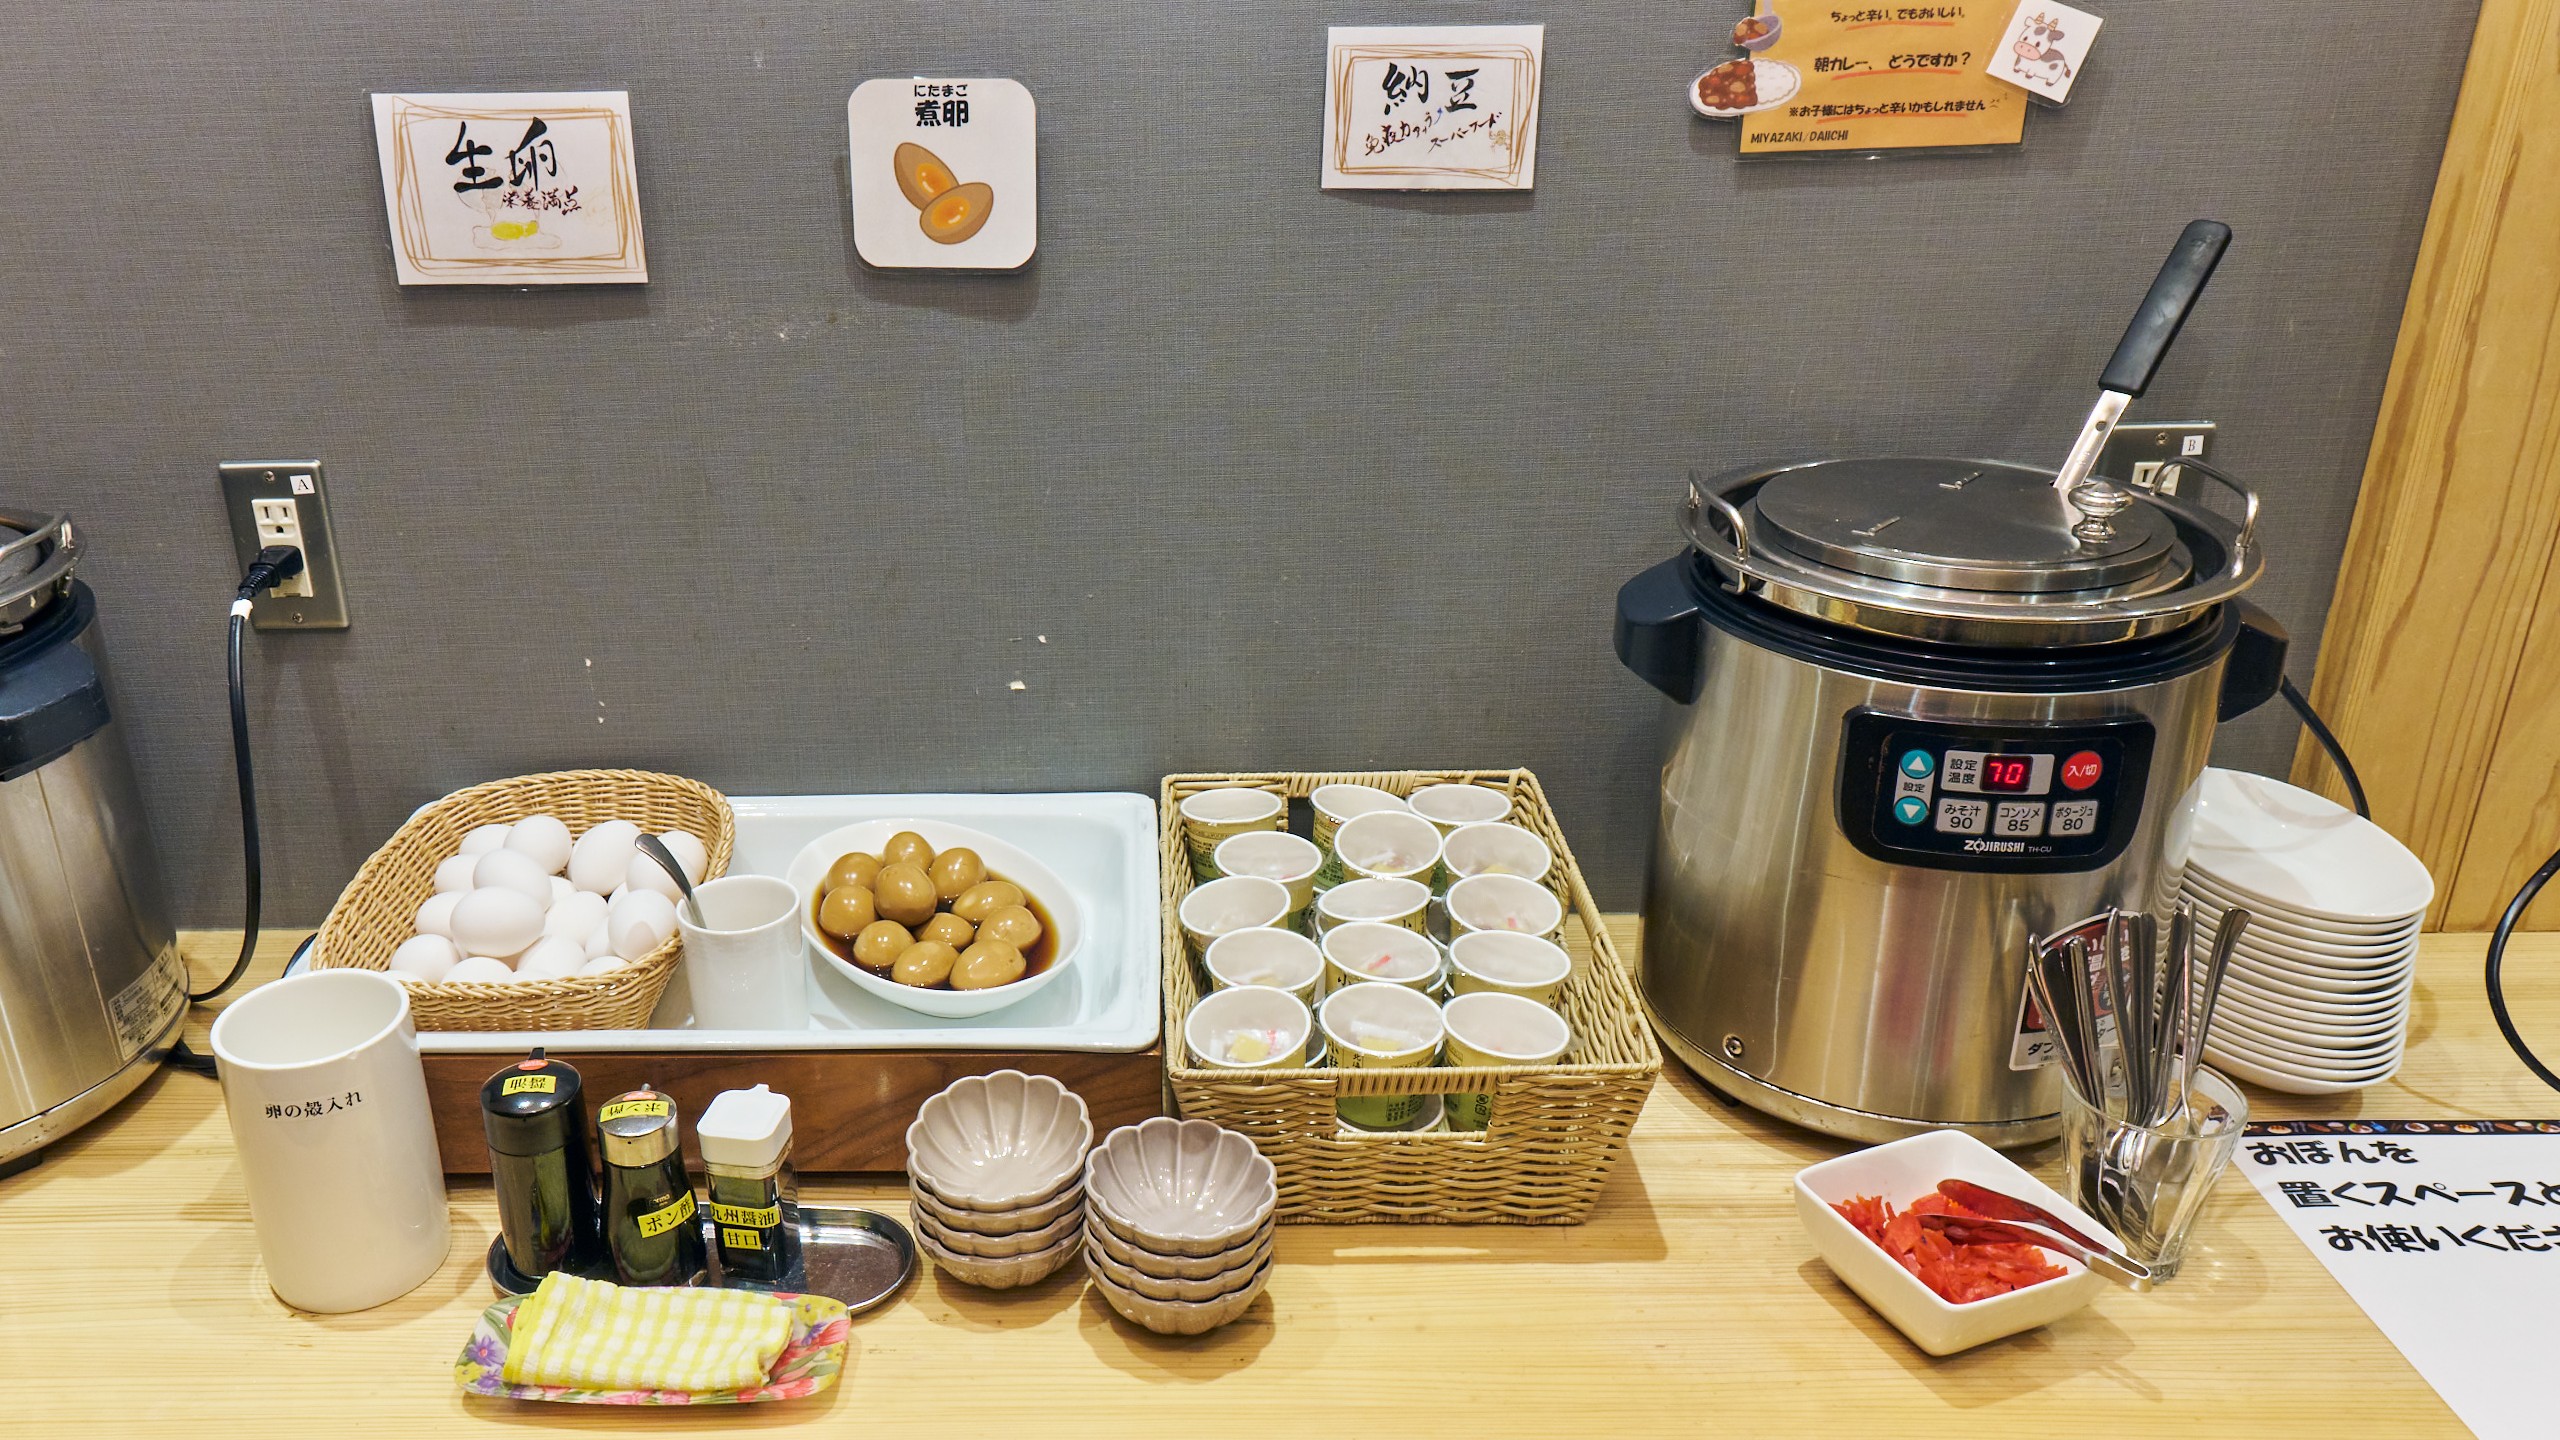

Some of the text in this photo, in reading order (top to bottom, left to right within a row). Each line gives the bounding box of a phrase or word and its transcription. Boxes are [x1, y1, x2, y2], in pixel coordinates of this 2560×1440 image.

[913, 84, 968, 97] にたまご
[1382, 62, 1480, 115] 納豆
[914, 99, 969, 127] 煮卵
[1428, 112, 1502, 153] スーパーフード
[446, 117, 557, 193] 生卵
[502, 186, 582, 215] 栄養満点
[2187, 438, 2197, 451] B
[297, 479, 309, 490] A
[1950, 758, 1978, 771] 設定
[2067, 764, 2098, 777] 入/切
[1948, 772, 1976, 785] 温度
[1989, 762, 2025, 784] 70
[1903, 781, 1926, 794] 設定
[1944, 804, 1981, 817] みそ汁
[2000, 807, 2040, 819] コンソメ
[2055, 806, 2094, 818] ポタージュ
[1950, 817, 1973, 830] 90
[2007, 819, 2029, 832] 85
[2062, 818, 2084, 831] 80
[1963, 837, 2026, 854] ZOJIRUSHI
[265, 1091, 363, 1119] 卵の殻入れ
[2245, 1140, 2419, 1166] おぼんを
[646, 1197, 692, 1233] ポン酢
[725, 1231, 758, 1246] 甘口
